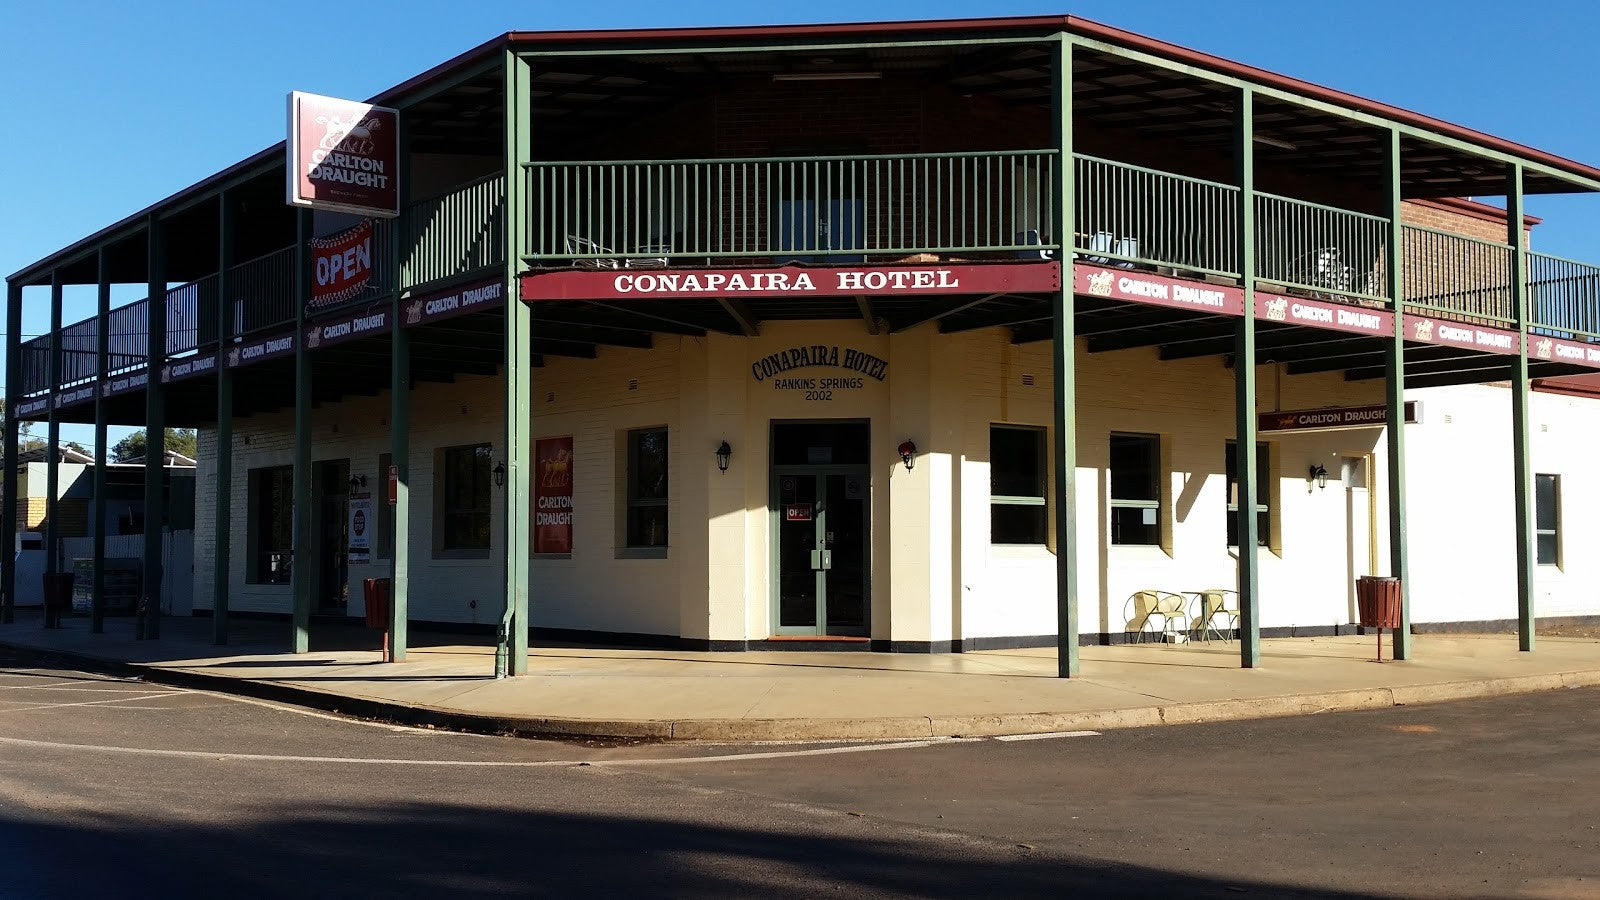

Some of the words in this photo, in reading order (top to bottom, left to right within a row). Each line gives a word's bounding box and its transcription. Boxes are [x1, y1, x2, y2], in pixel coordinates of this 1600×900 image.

[312, 149, 384, 174] CARLTON
[308, 162, 388, 189] DRAUGHT
[316, 237, 371, 286] OPEN
[613, 272, 817, 293] CONAPAIRA
[836, 270, 959, 291] HOTEL
[1118, 277, 1168, 300] CARLTON
[1172, 284, 1225, 307] DRAUGHT
[425, 294, 459, 315] CARLTON
[462, 284, 502, 306] DRAUGHT
[323, 321, 351, 340] CARLTON
[353, 313, 386, 333] DRAUGHT
[751, 345, 840, 381] CONAPAIRA
[842, 347, 889, 382] HOTEL
[774, 378, 816, 390] RANKINS
[819, 377, 864, 389] SPRINGS
[805, 390, 833, 401] 2002
[1299, 412, 1341, 425] CARLTON
